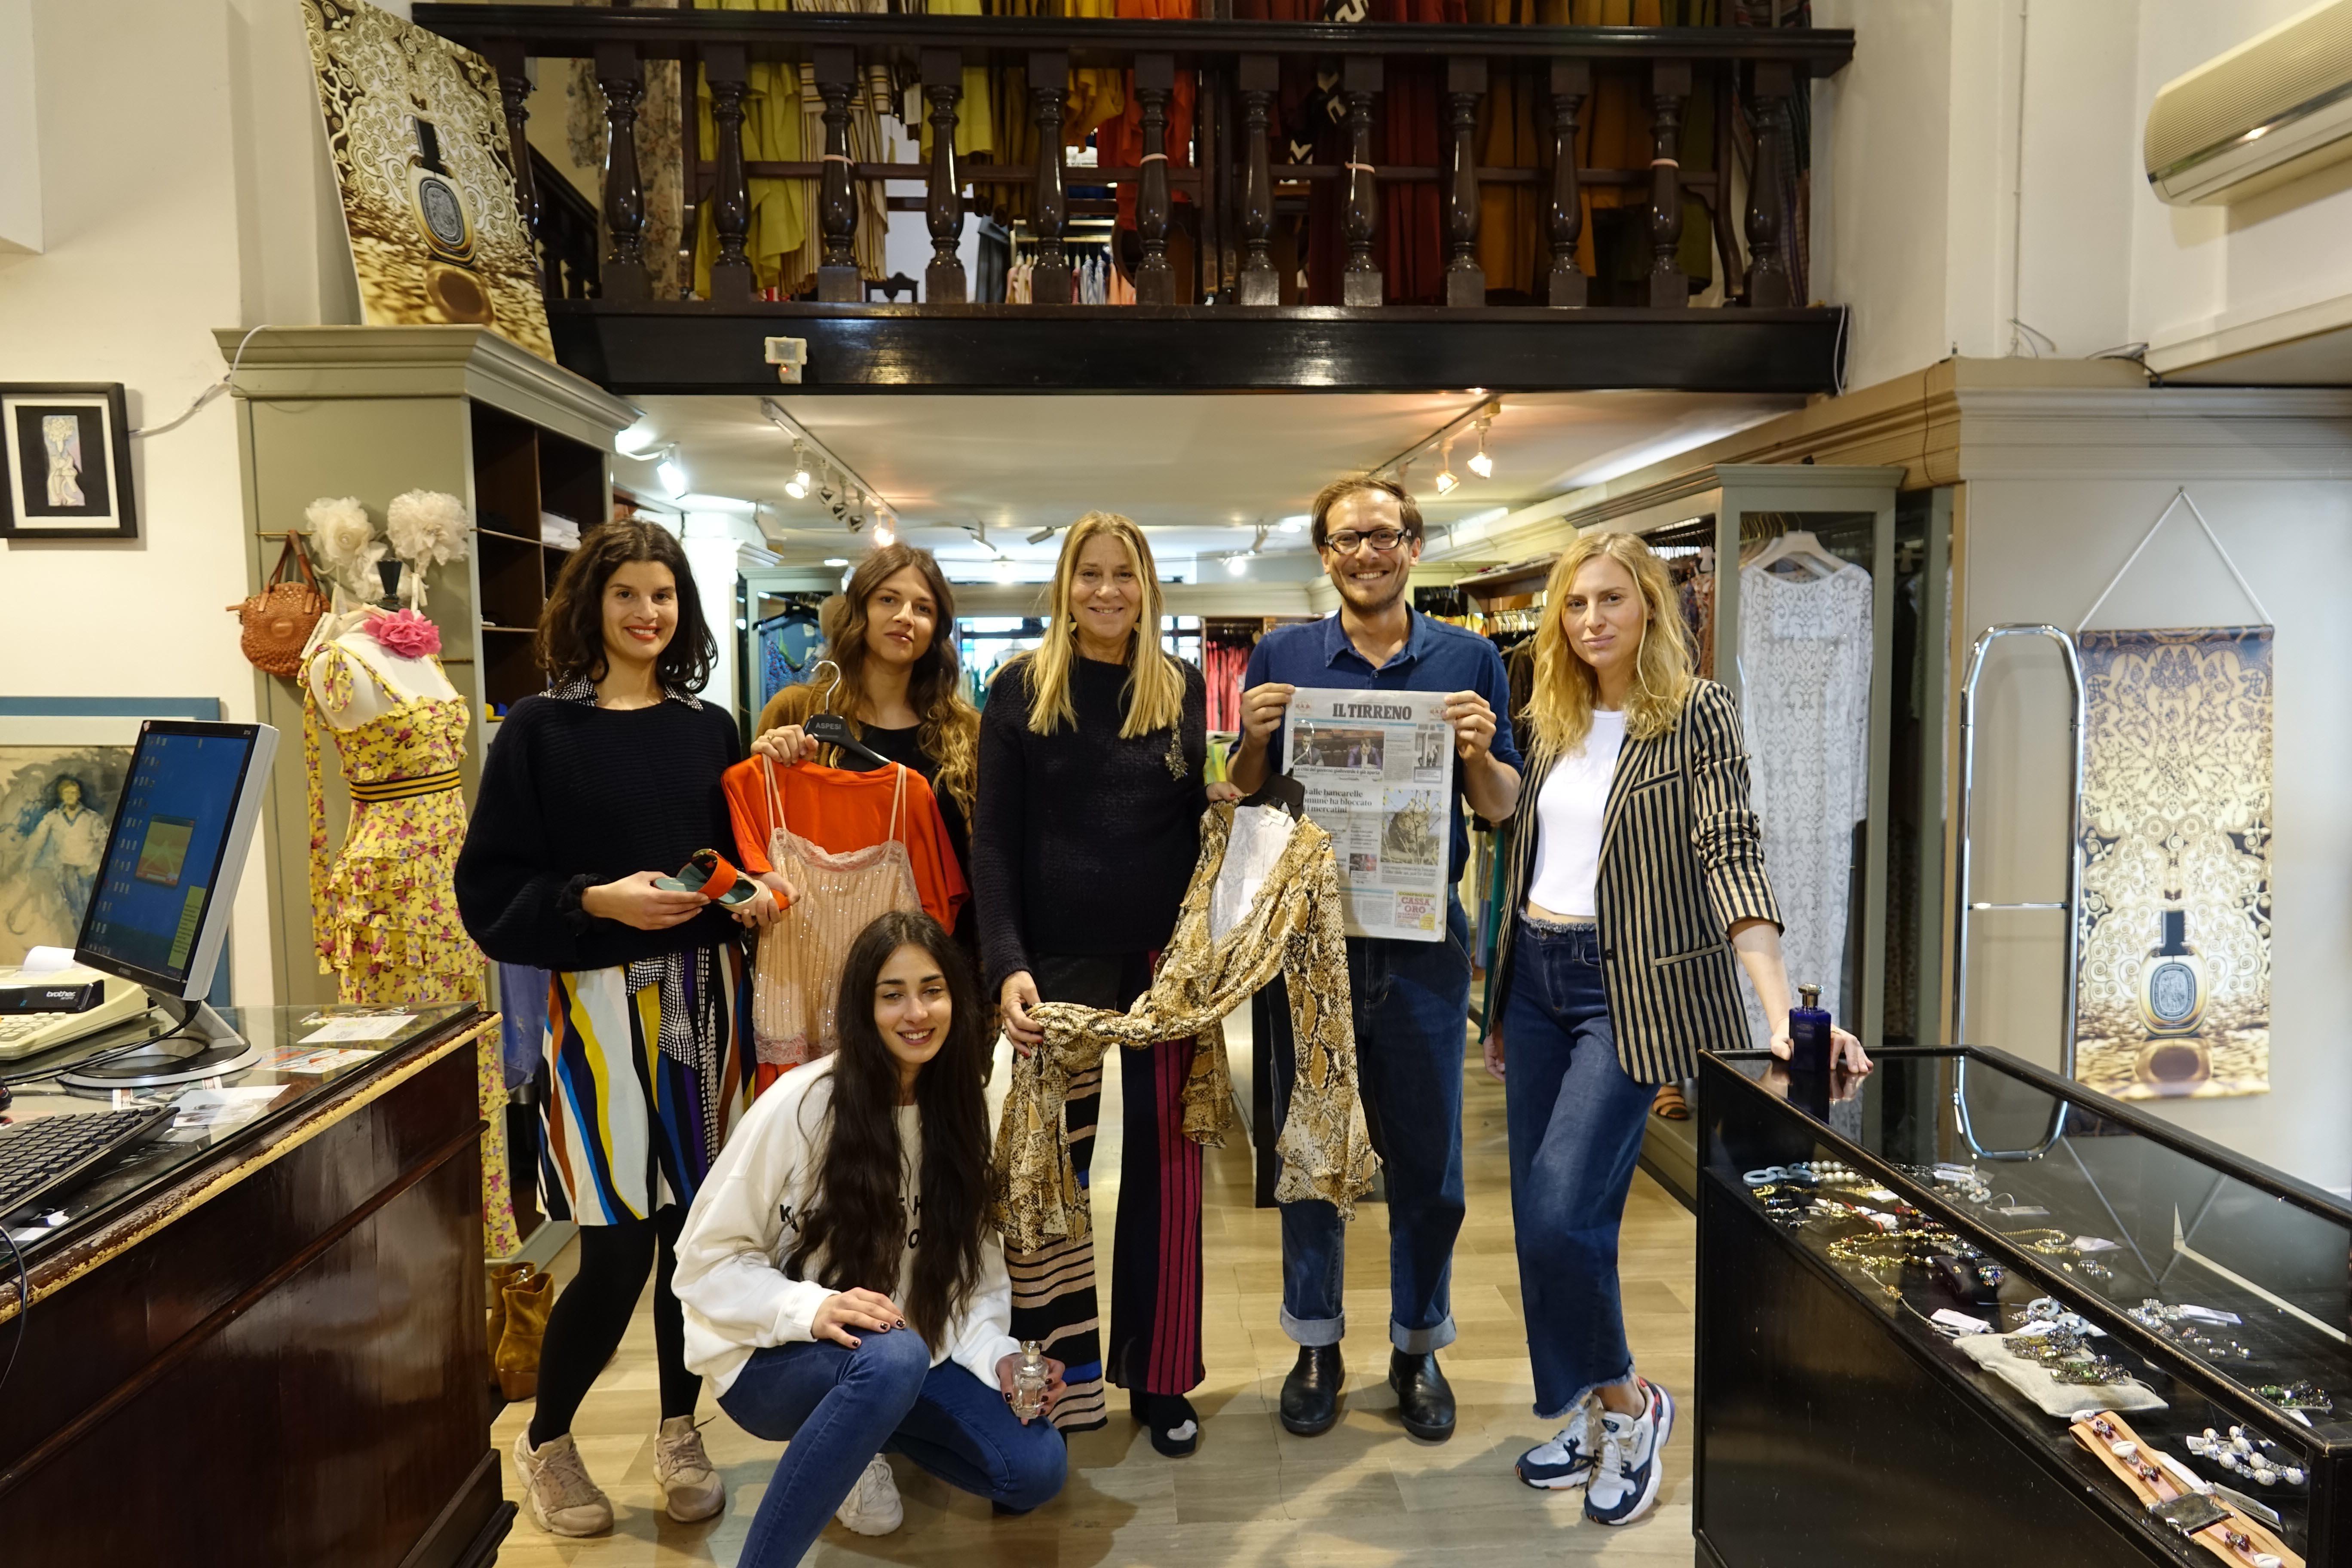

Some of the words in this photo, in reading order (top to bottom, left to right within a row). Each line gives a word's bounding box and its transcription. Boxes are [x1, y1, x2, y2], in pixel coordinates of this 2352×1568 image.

[1333, 703, 1346, 717] IL
[1348, 703, 1412, 720] TIRRENO
[1324, 789, 1363, 798] bancarelle
[1341, 798, 1372, 806] bloccato
[1402, 897, 1430, 906] CASSA
[1404, 905, 1426, 914] ORO
